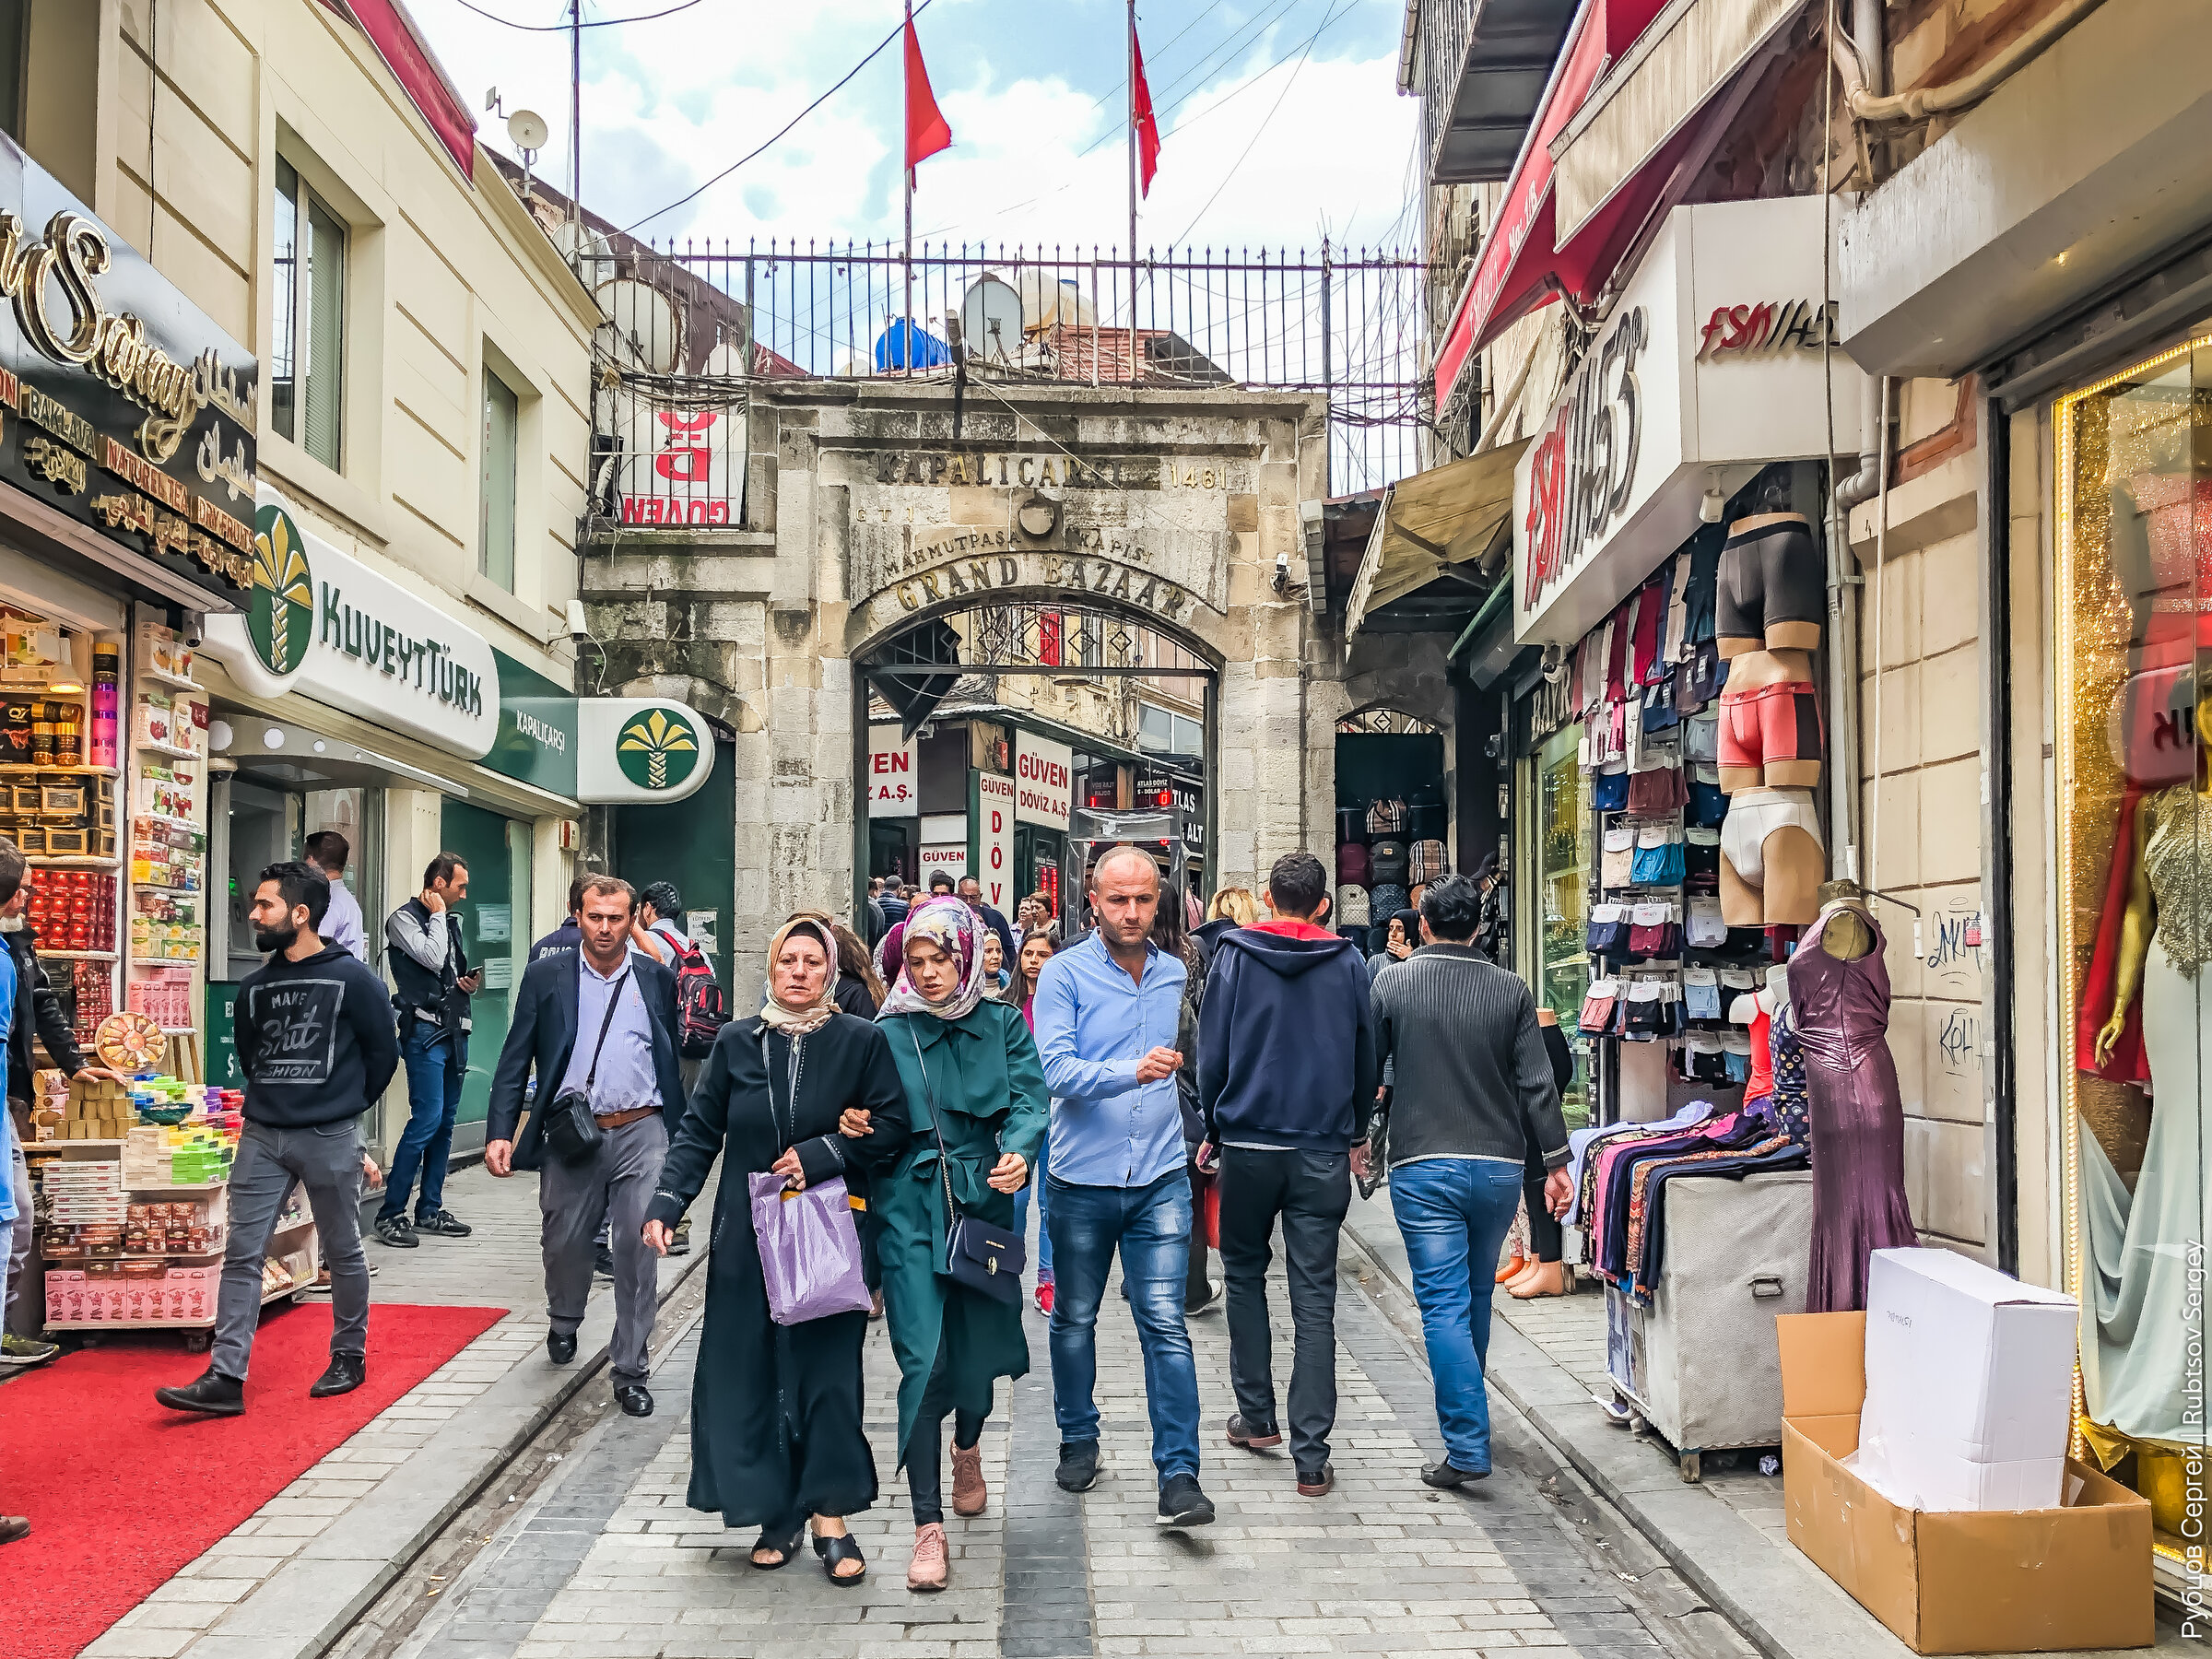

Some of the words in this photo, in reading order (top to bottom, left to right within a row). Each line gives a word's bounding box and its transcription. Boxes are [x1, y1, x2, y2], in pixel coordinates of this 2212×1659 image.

[29, 383, 97, 461] BAKLAVA
[106, 435, 167, 502] NATUREL
[168, 475, 189, 517] TEA
[1170, 464, 1228, 490] 1461
[197, 495, 219, 534] DRY
[218, 512, 255, 556] FRUITS
[897, 557, 1018, 612] GRAND
[1043, 554, 1186, 619] BAZAAR
[516, 709, 565, 756] KAPALIÇARŞI
[868, 751, 909, 774] EN
[1018, 751, 1067, 790] GÜVEN
[878, 783, 912, 803] A.Ş.
[981, 777, 1014, 798] GÜVEN
[1019, 788, 1050, 816] DÖVİZ
[1052, 799, 1069, 821] A.Ş.
[923, 850, 965, 863] GÜVEN
[271, 991, 308, 1009] MAKE
